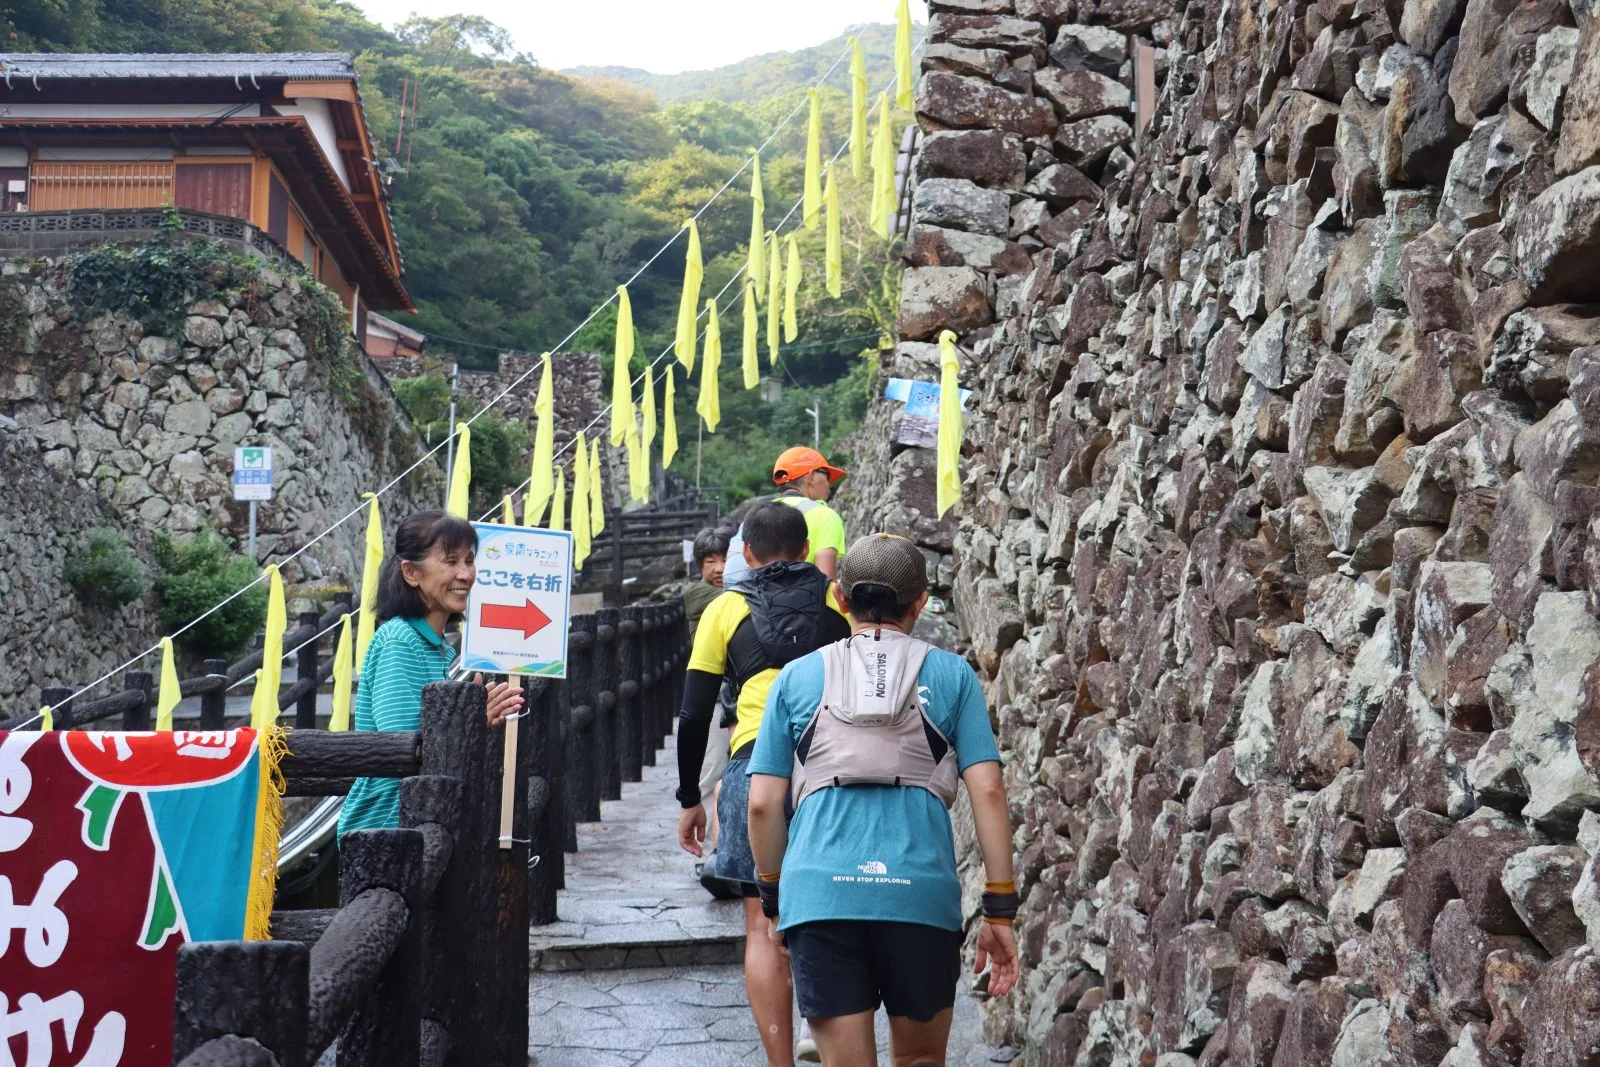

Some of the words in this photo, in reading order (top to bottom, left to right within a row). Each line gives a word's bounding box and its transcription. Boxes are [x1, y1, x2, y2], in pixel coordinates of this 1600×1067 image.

[477, 569, 563, 593] ここを右折
[876, 653, 887, 699] SALOMON
[875, 877, 912, 885] EXPLORING
